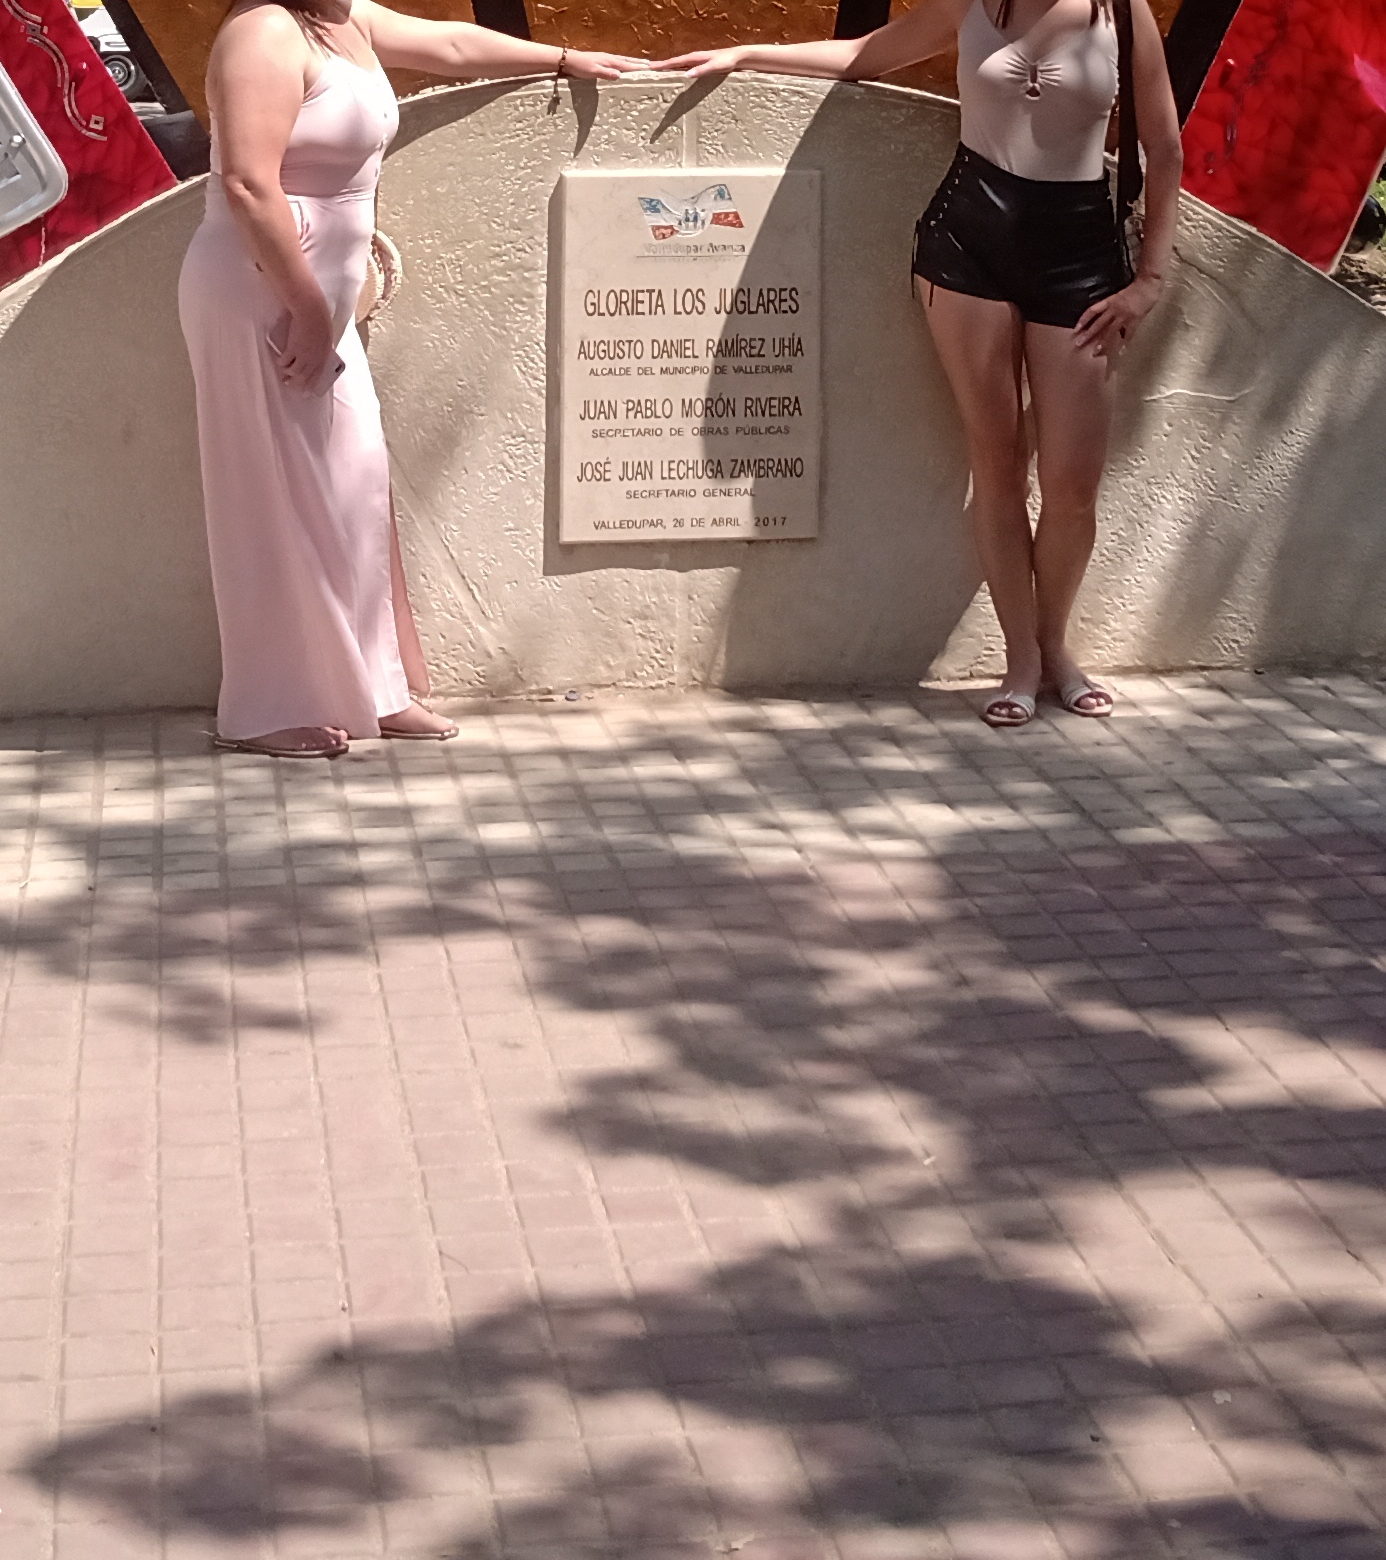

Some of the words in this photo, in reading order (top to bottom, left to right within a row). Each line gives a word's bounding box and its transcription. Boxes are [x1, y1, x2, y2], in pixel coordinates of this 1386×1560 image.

[584, 289, 665, 317] GLORIETA
[673, 288, 706, 315] LOS
[714, 287, 800, 315] JUGLARES
[577, 340, 644, 360] AUGUSTO
[651, 339, 699, 359] DANIEL
[706, 333, 765, 358] RAMÍREZ
[772, 332, 804, 357] UHÍA
[589, 366, 631, 376] ALCALDE
[637, 366, 655, 375] DEL
[660, 366, 709, 375] MUNICIPIO
[715, 365, 727, 374] DE
[732, 364, 793, 374] VALLEDUPAR
[579, 399, 617, 420] JUAN
[625, 398, 673, 419] PABLO
[681, 392, 736, 418] MORÓN
[744, 396, 802, 417] RIVEIRA
[591, 428, 663, 438] SECRETARIO
[669, 427, 684, 437] DE
[691, 426, 729, 436] OBRAS
[735, 424, 790, 436] PÚBLICAS
[576, 457, 611, 482] JOSÉ
[618, 460, 653, 481] JUAN
[660, 459, 724, 480] LECHUGA
[729, 457, 804, 479] ZAMBRANO
[625, 489, 696, 499] SECRETARIO
[702, 488, 756, 498] GENERAL
[593, 519, 666, 530] VALLEDUPAR,
[691, 517, 705, 528] DE
[710, 517, 741, 527] ABRIL
[754, 516, 787, 527] 2017
